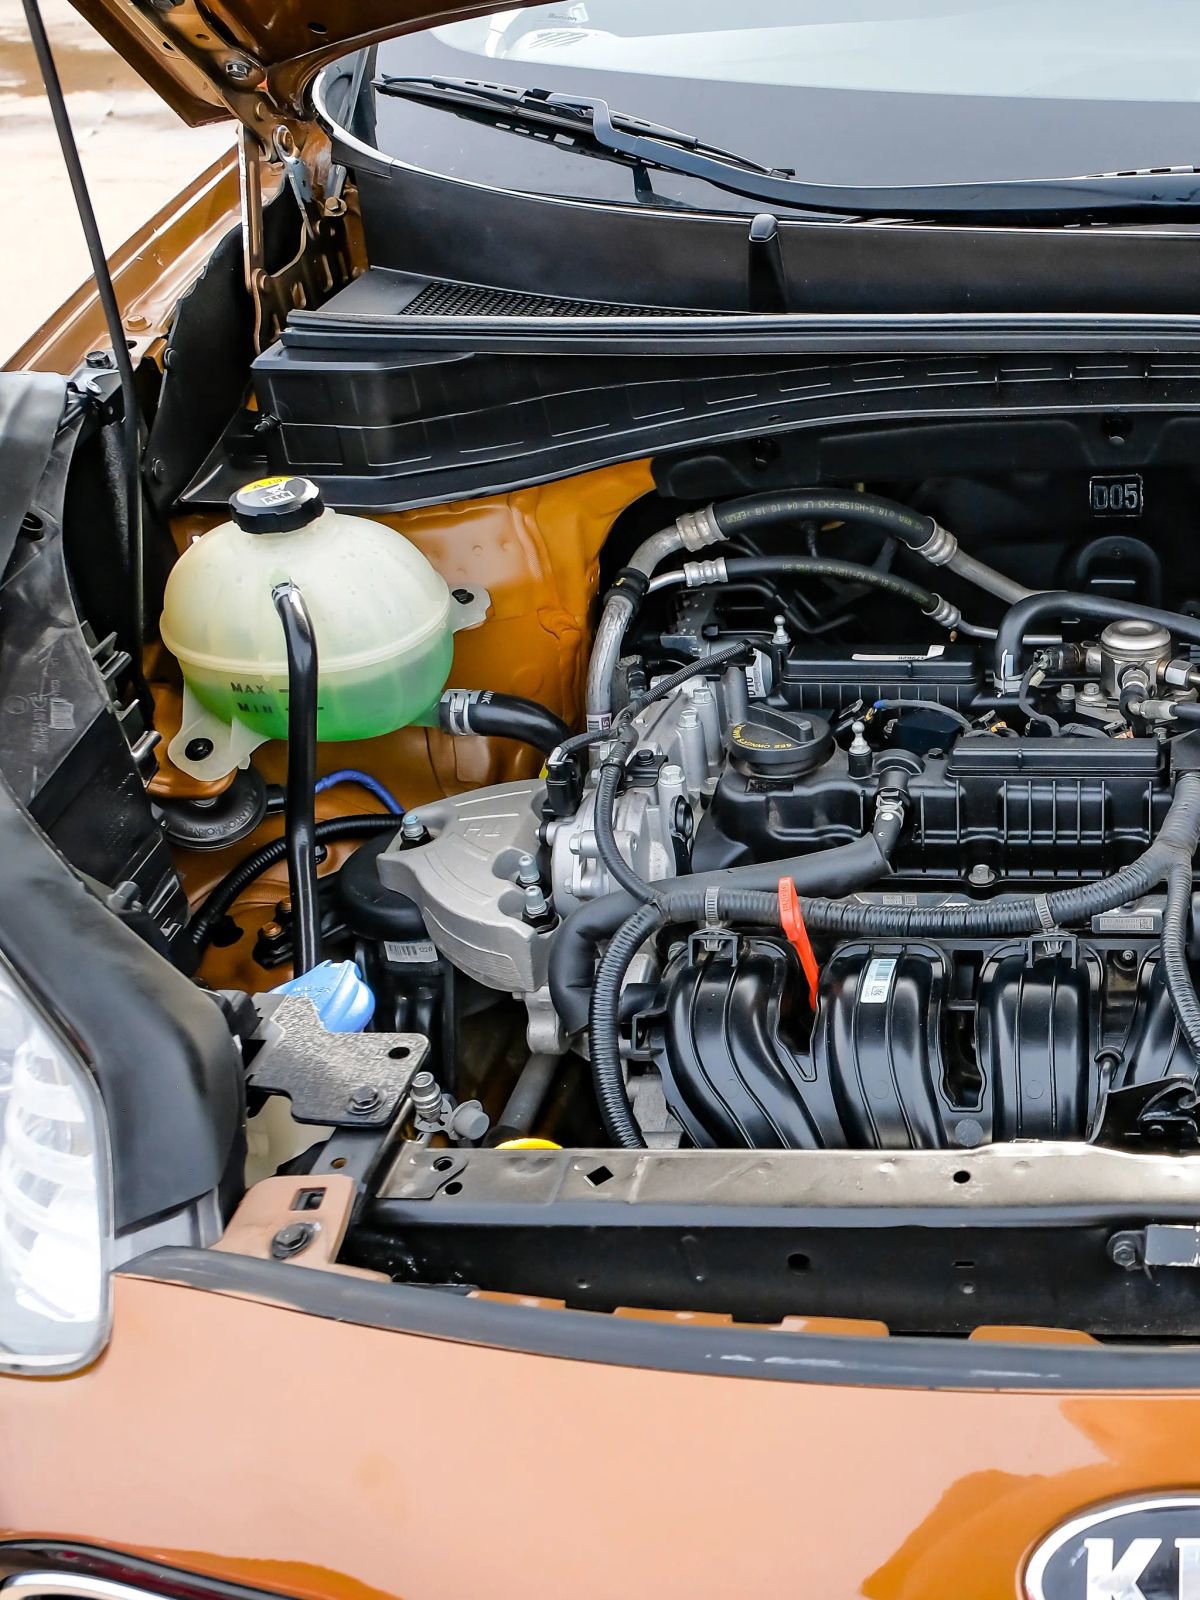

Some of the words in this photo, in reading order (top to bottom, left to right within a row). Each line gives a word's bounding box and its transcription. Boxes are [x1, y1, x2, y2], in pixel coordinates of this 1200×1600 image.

[1093, 483, 1138, 509] D05
[230, 682, 265, 694] MAX
[237, 703, 273, 714] MIN
